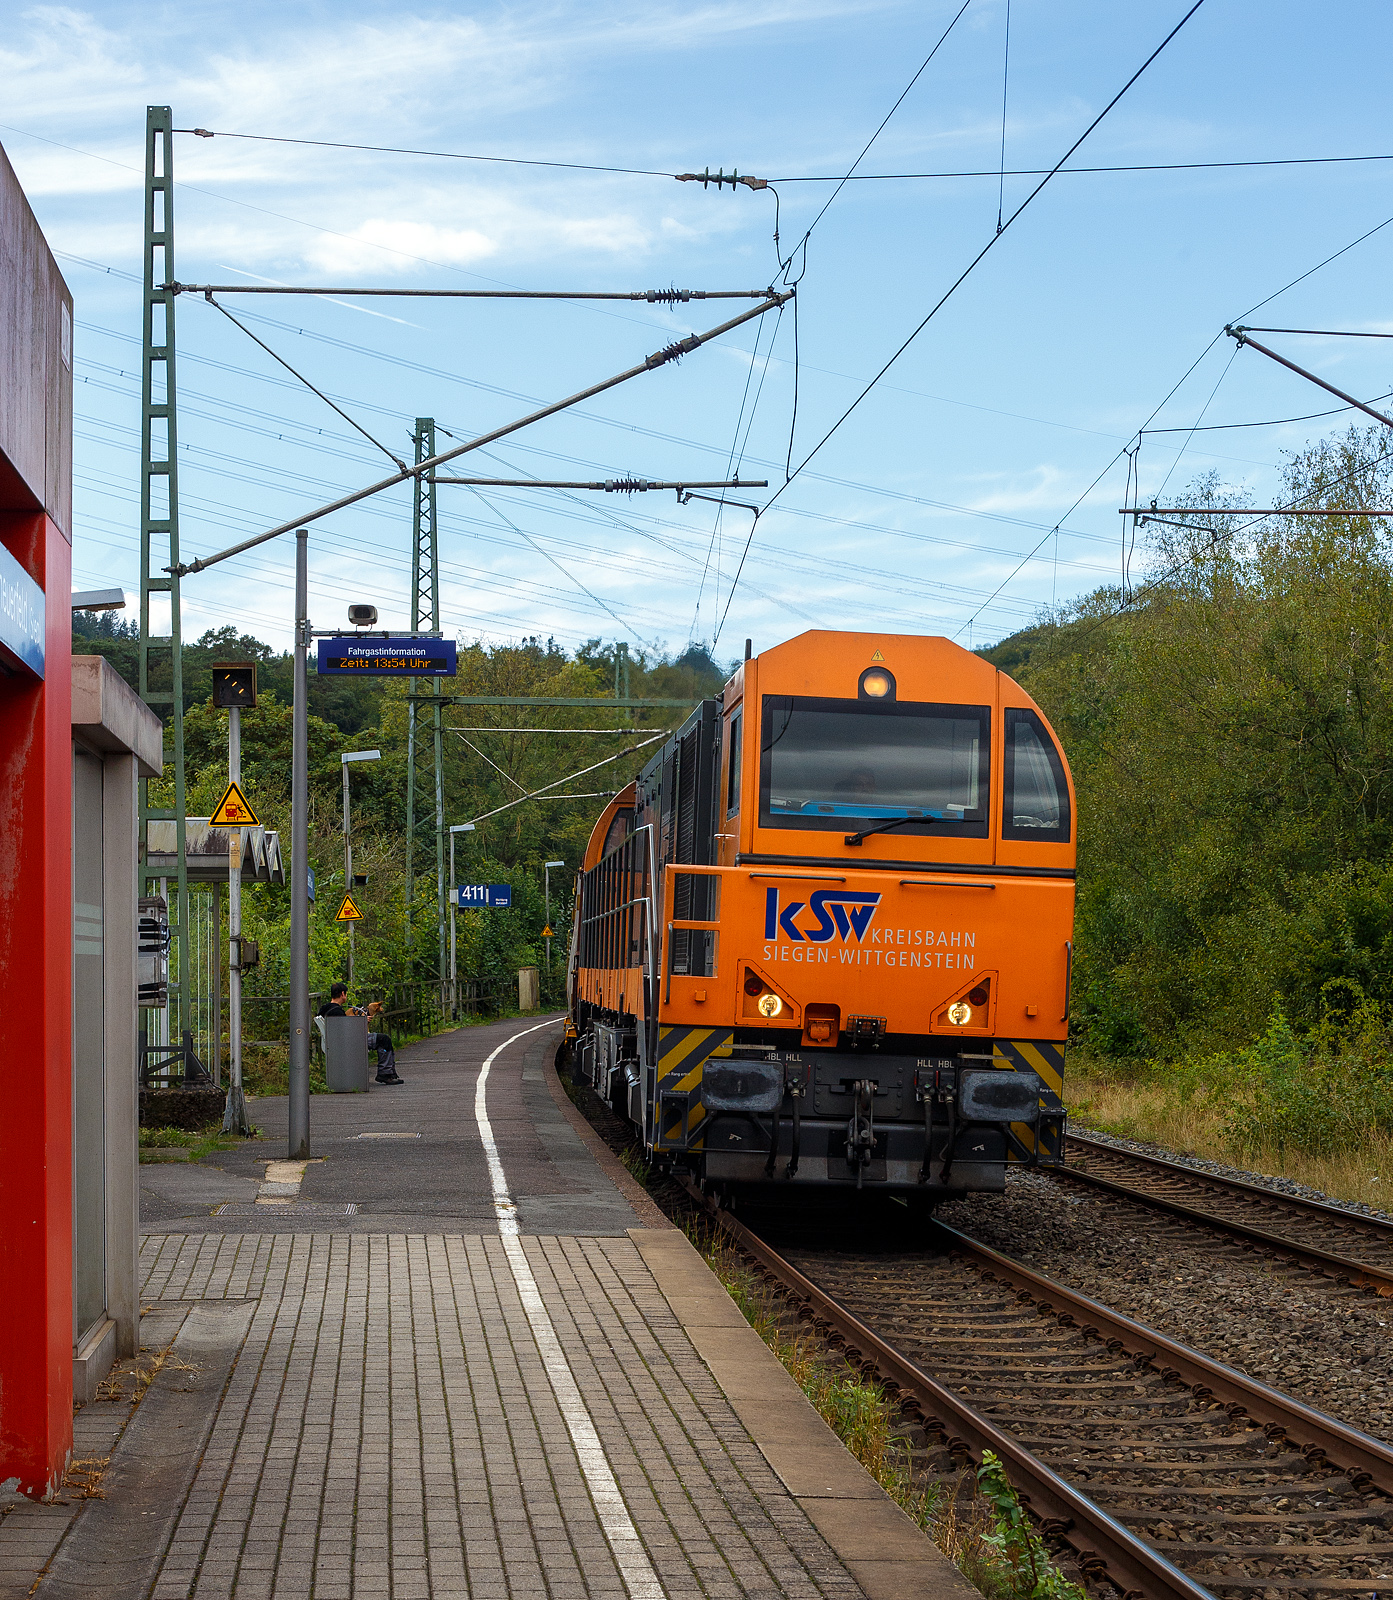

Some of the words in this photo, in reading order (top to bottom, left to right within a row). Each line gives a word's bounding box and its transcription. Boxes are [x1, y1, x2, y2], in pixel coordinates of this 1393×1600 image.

[348, 647, 426, 657] Fahrgastinformation
[340, 658, 369, 668] Zeit:
[373, 658, 406, 668] 13:54
[410, 658, 431, 668] Uhr
[462, 885, 484, 900] 411
[872, 928, 976, 948] KREISBAHN
[763, 945, 975, 970] SIEGEN-WITTGENSTEIN
[764, 1052, 782, 1061] HBL
[785, 1053, 802, 1062] HLL
[917, 1059, 933, 1068] HLL
[938, 1060, 955, 1069] HBL
